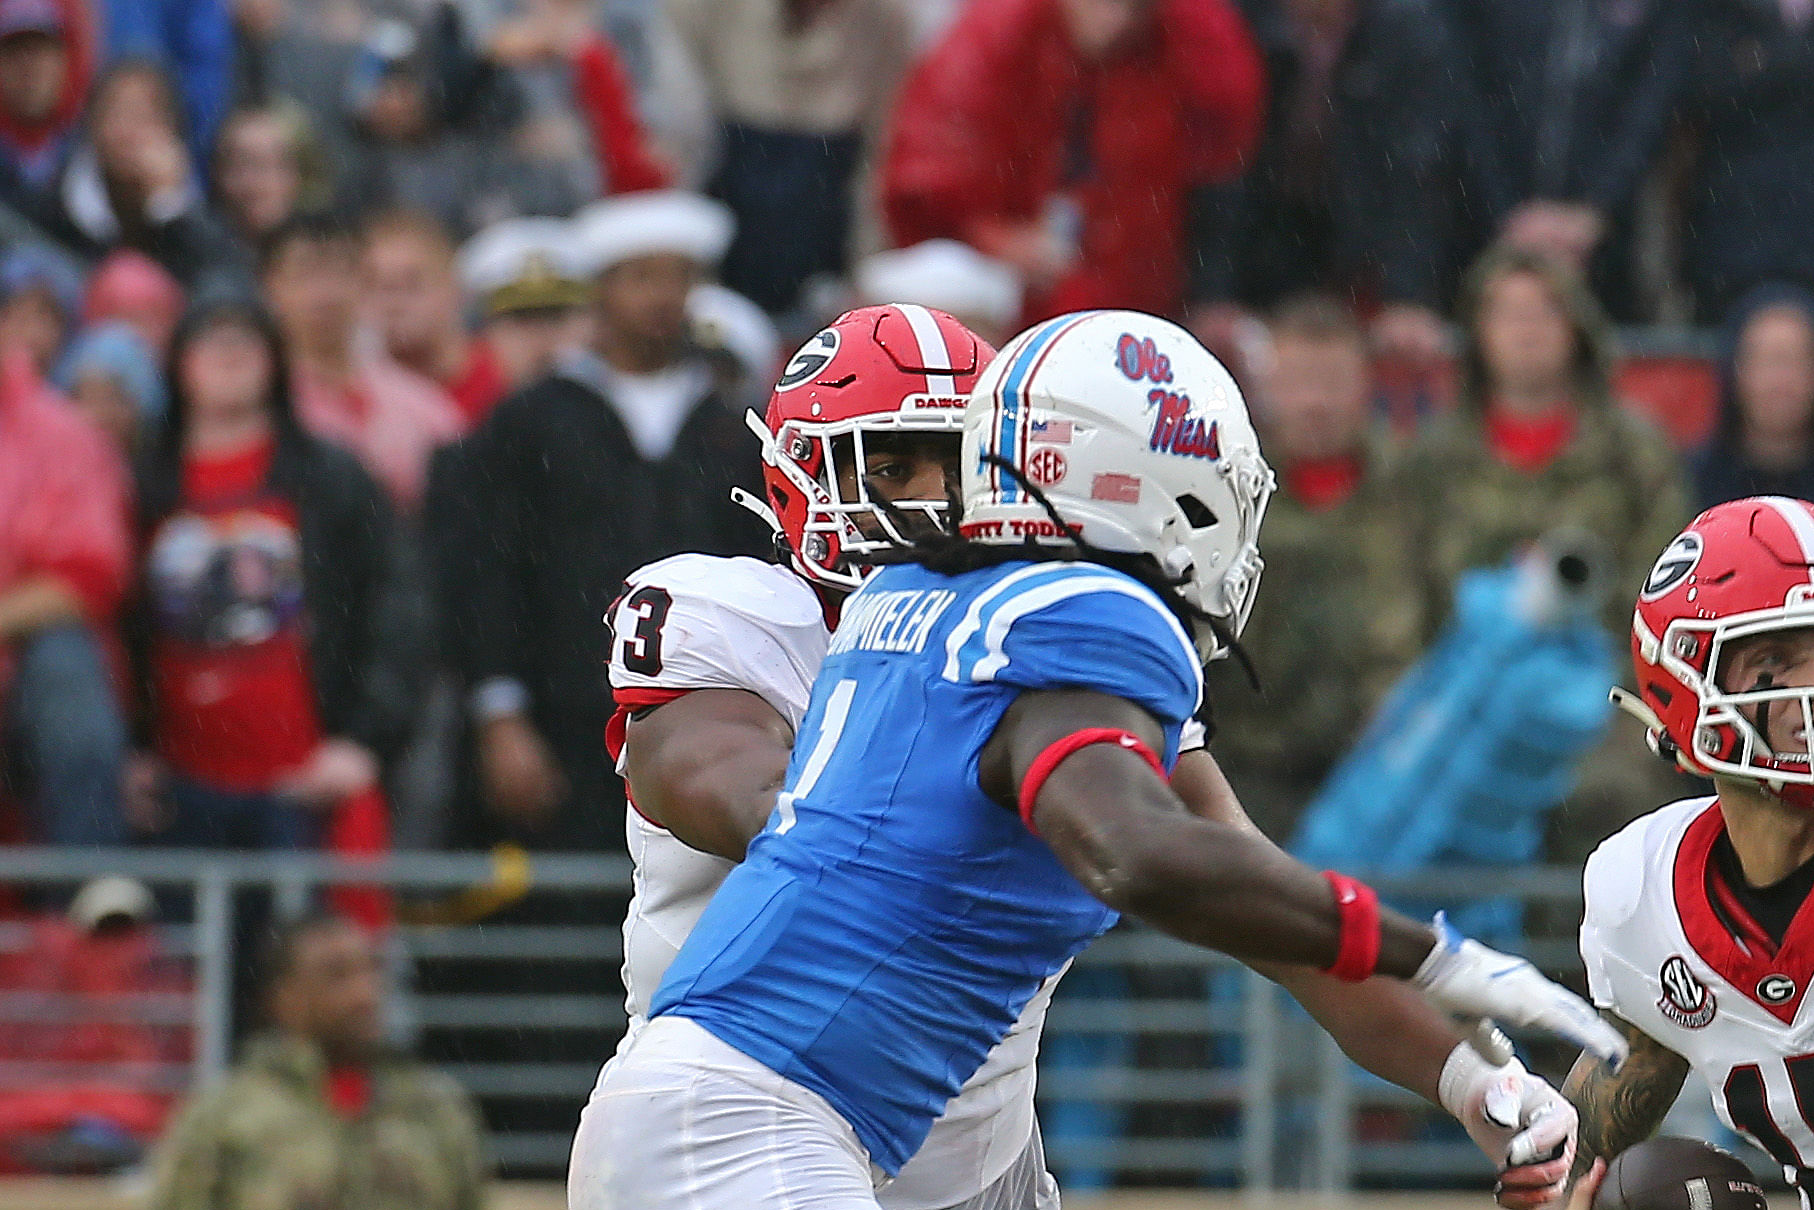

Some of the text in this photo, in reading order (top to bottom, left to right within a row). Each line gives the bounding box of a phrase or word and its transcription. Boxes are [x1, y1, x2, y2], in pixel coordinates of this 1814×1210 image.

[1116, 333, 1173, 383] Ole
[914, 397, 969, 409] DAWG
[1148, 388, 1221, 461] Miss
[1031, 455, 1064, 484] SEC
[605, 582, 673, 678] 3
[776, 679, 858, 835] 1
